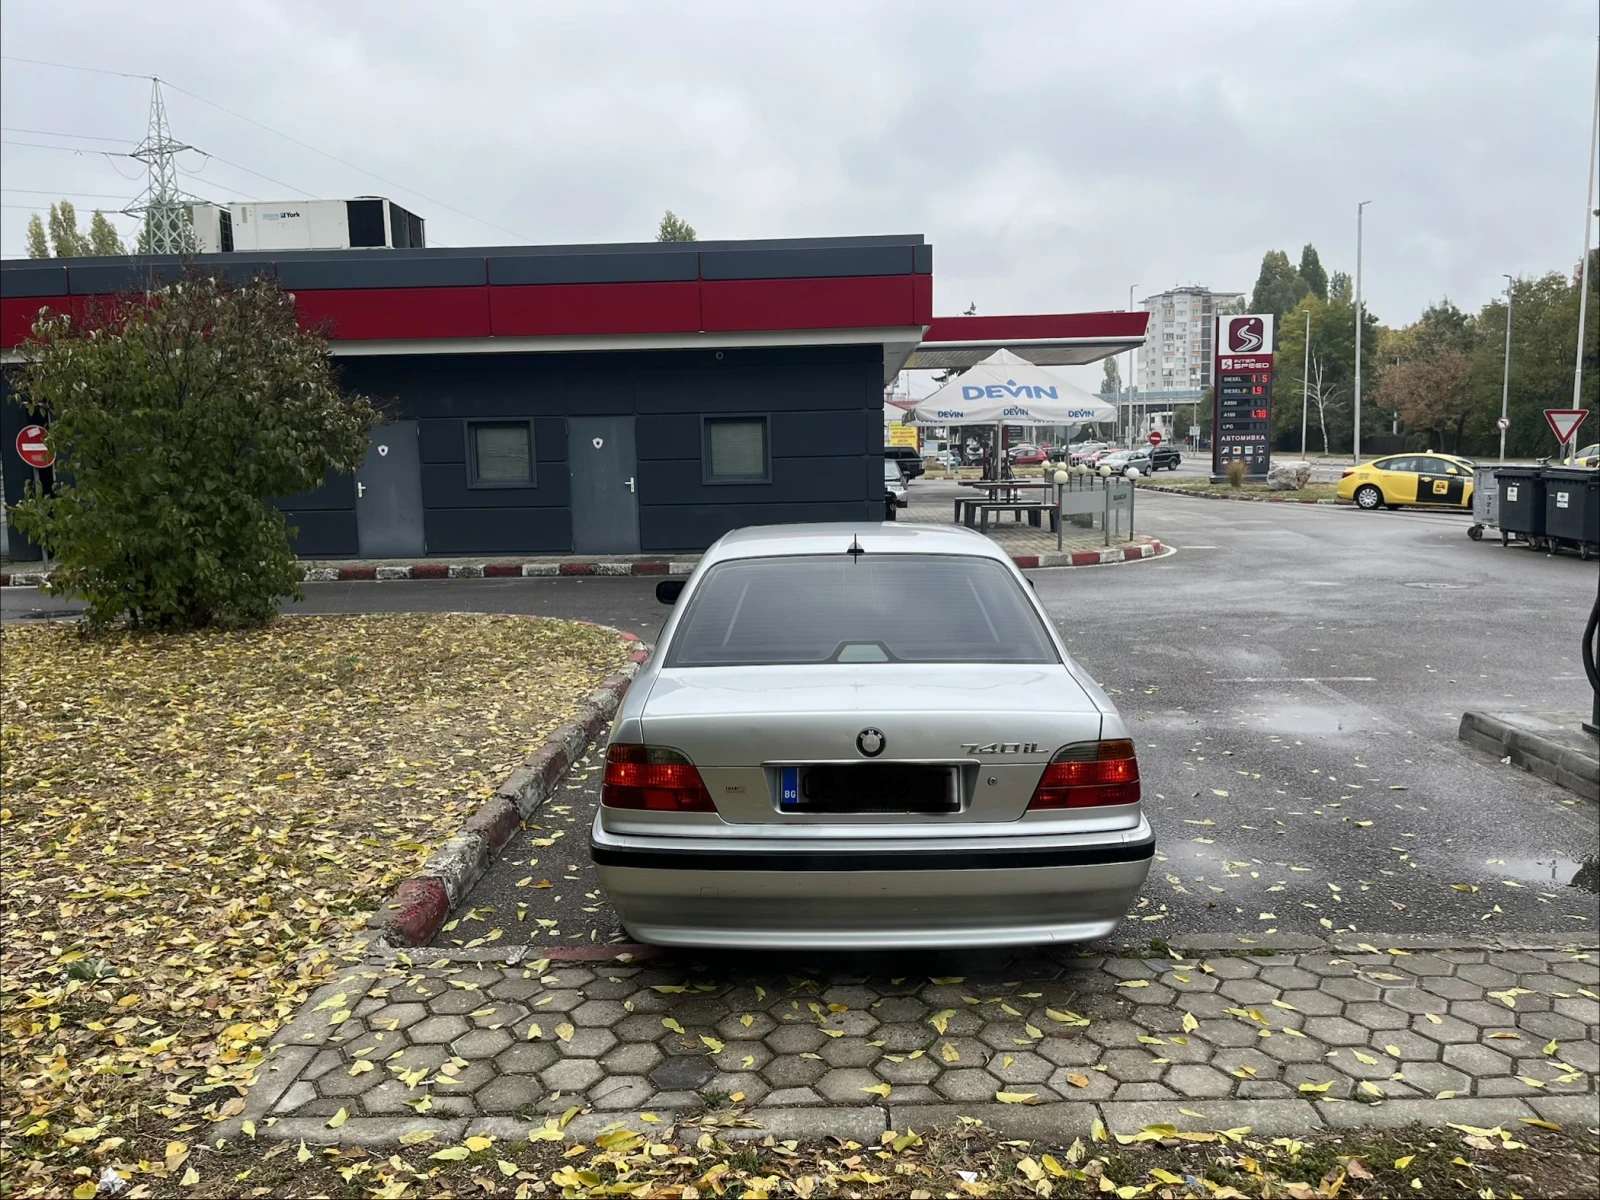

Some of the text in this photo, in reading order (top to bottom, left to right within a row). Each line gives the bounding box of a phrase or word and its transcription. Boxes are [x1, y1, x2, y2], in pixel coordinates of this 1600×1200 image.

[962, 379, 1058, 400] DEVIN
[937, 409, 964, 418] DEVIN
[1003, 406, 1029, 416] DEVIN
[1068, 408, 1094, 418] DEVIN
[784, 790, 796, 798] BG
